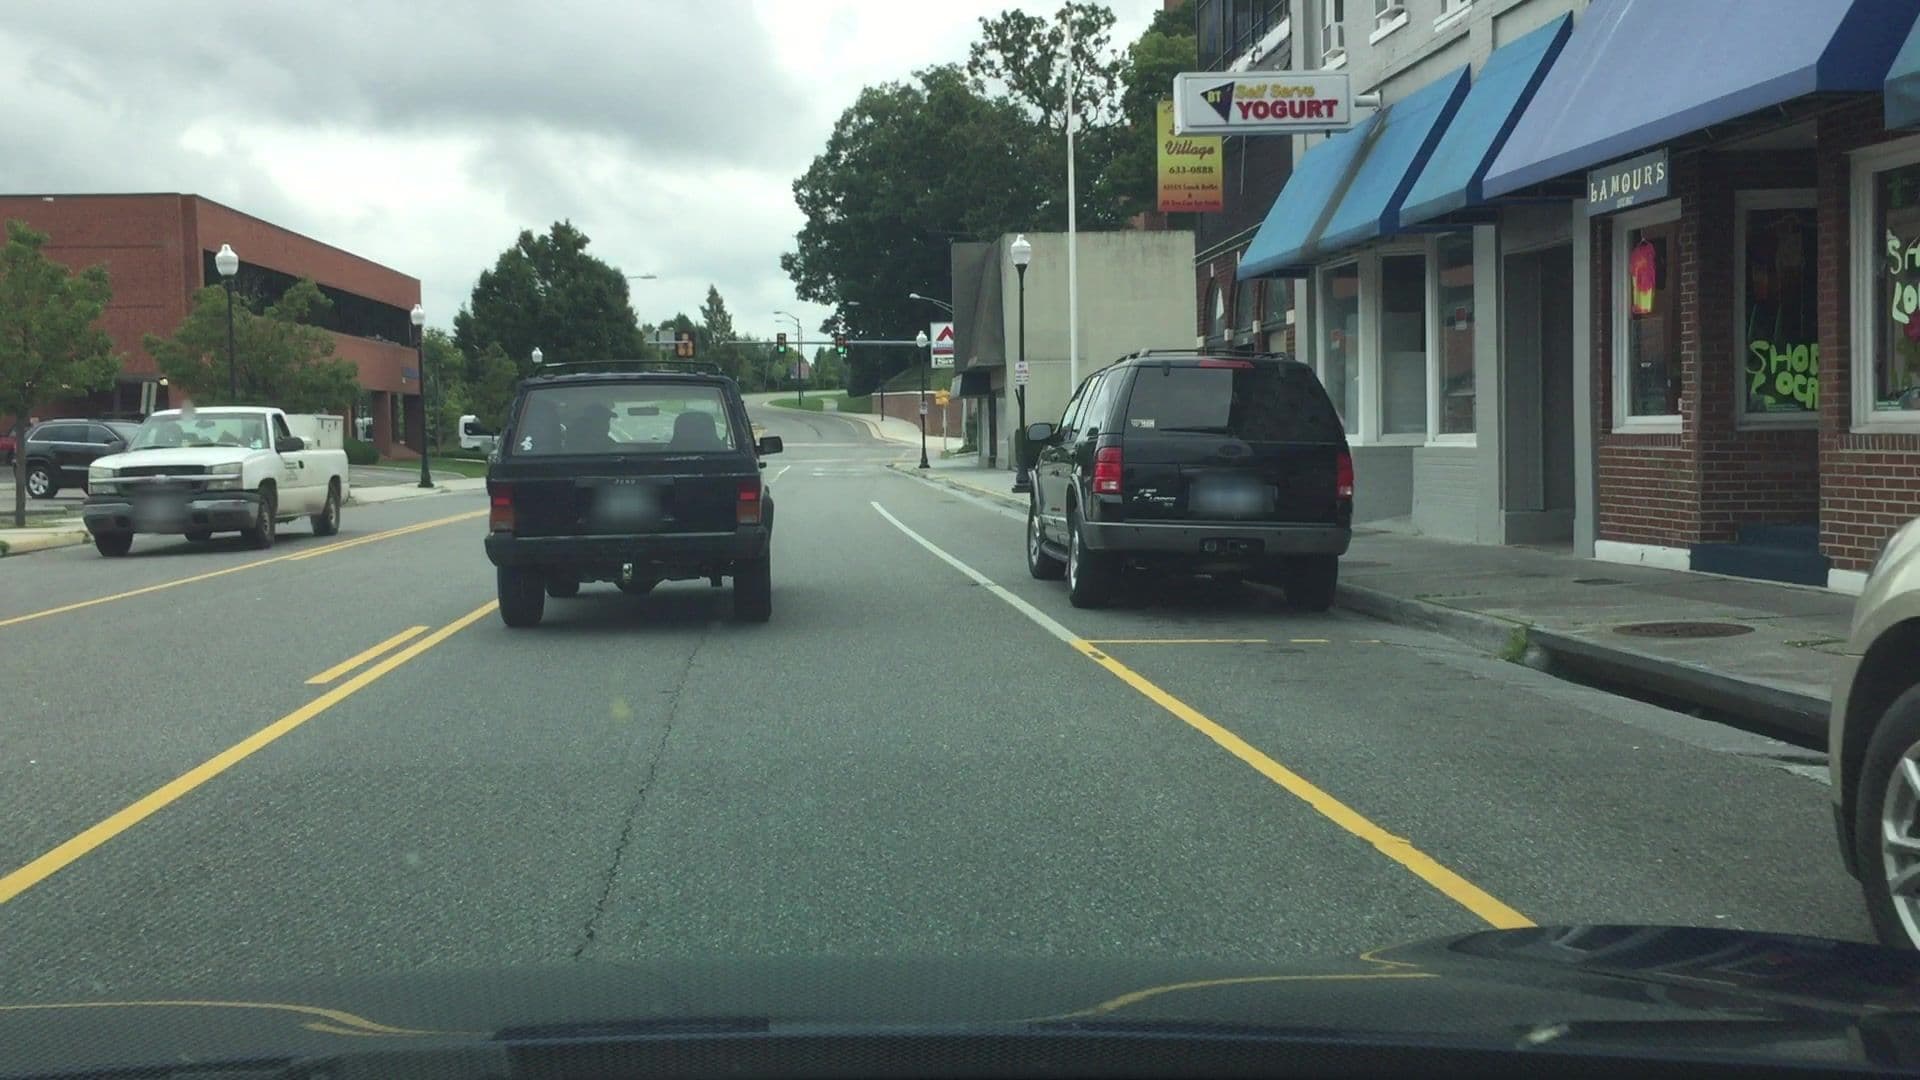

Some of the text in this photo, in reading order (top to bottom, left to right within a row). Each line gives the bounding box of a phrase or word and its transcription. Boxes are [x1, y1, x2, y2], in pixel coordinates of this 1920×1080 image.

[1236, 84, 1316, 98] Self Serve
[1236, 99, 1338, 120] YOGURT
[1165, 139, 1215, 160] Village
